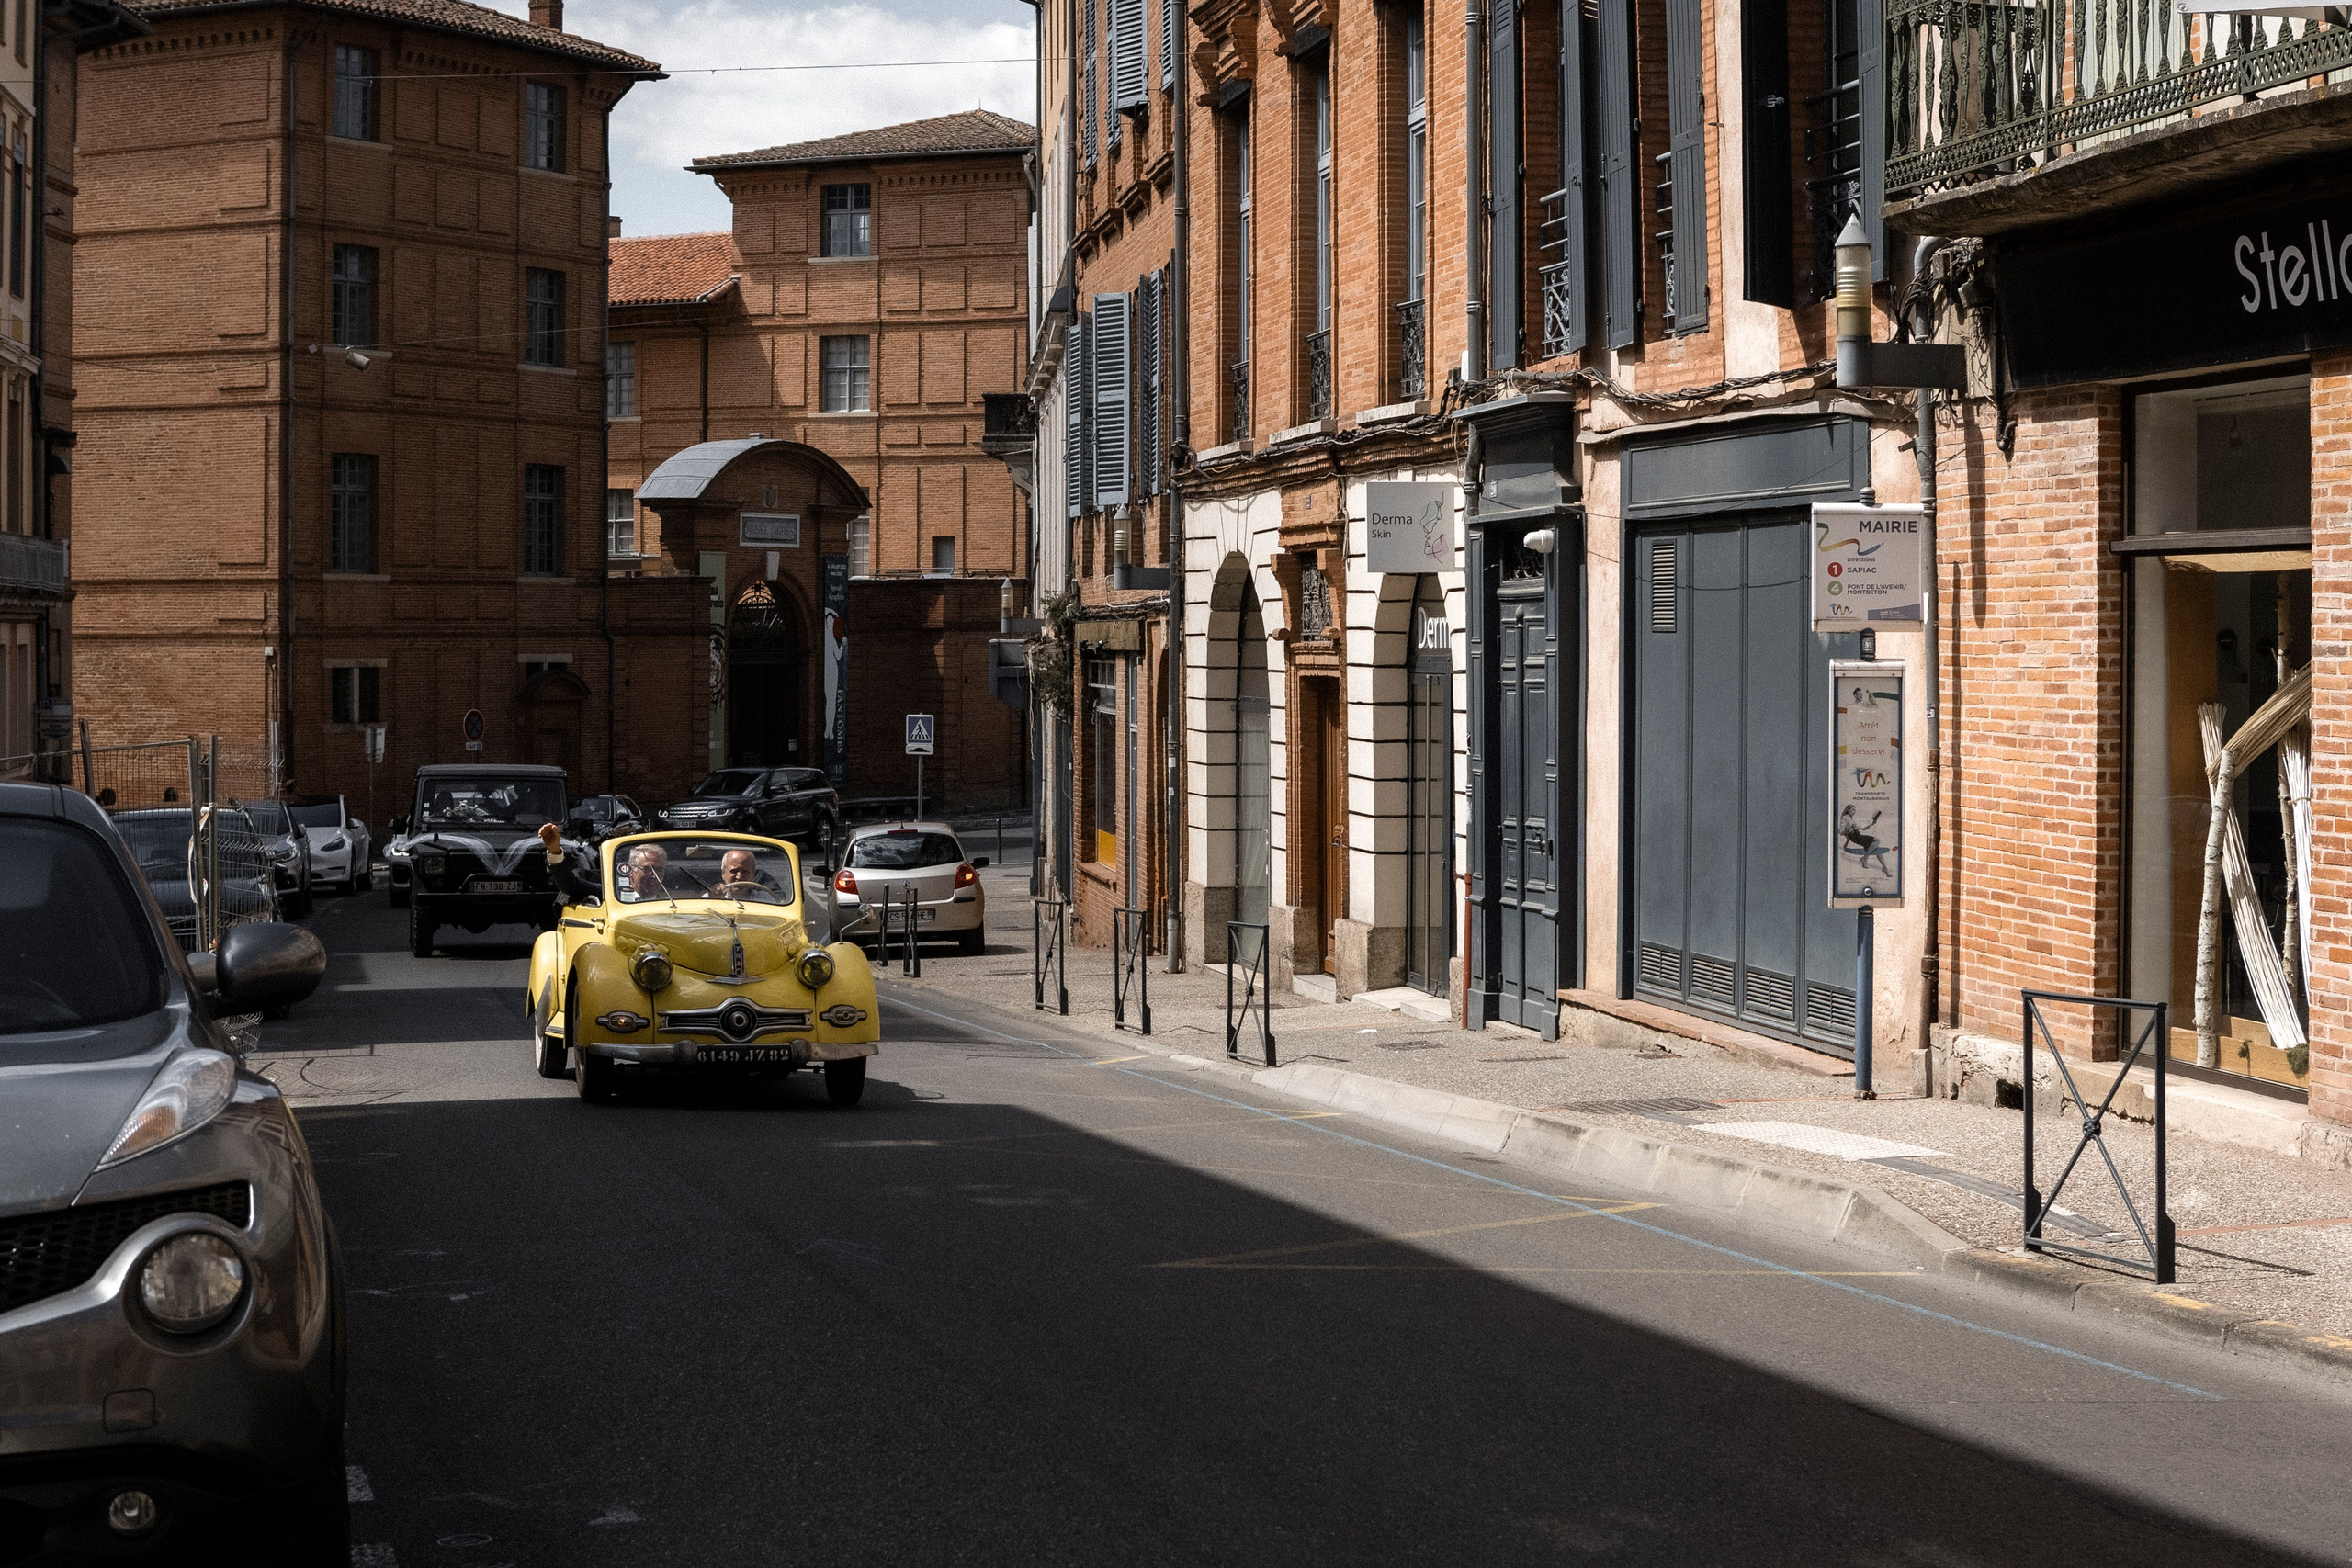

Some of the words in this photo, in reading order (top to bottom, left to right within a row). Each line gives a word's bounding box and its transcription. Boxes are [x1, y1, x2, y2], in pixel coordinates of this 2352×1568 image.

[1372, 513, 1413, 525] Derma
[1860, 520, 1917, 533] MAIRIE
[1372, 529, 1392, 538] Skin
[1832, 565, 1838, 575] 1
[1831, 583, 1840, 594] 4
[1852, 747, 1885, 755] desservi
[475, 882, 516, 891] FN-198-ZJ
[697, 1050, 740, 1063] 6149
[745, 1049, 765, 1062] JZ
[769, 1048, 789, 1062] 82
